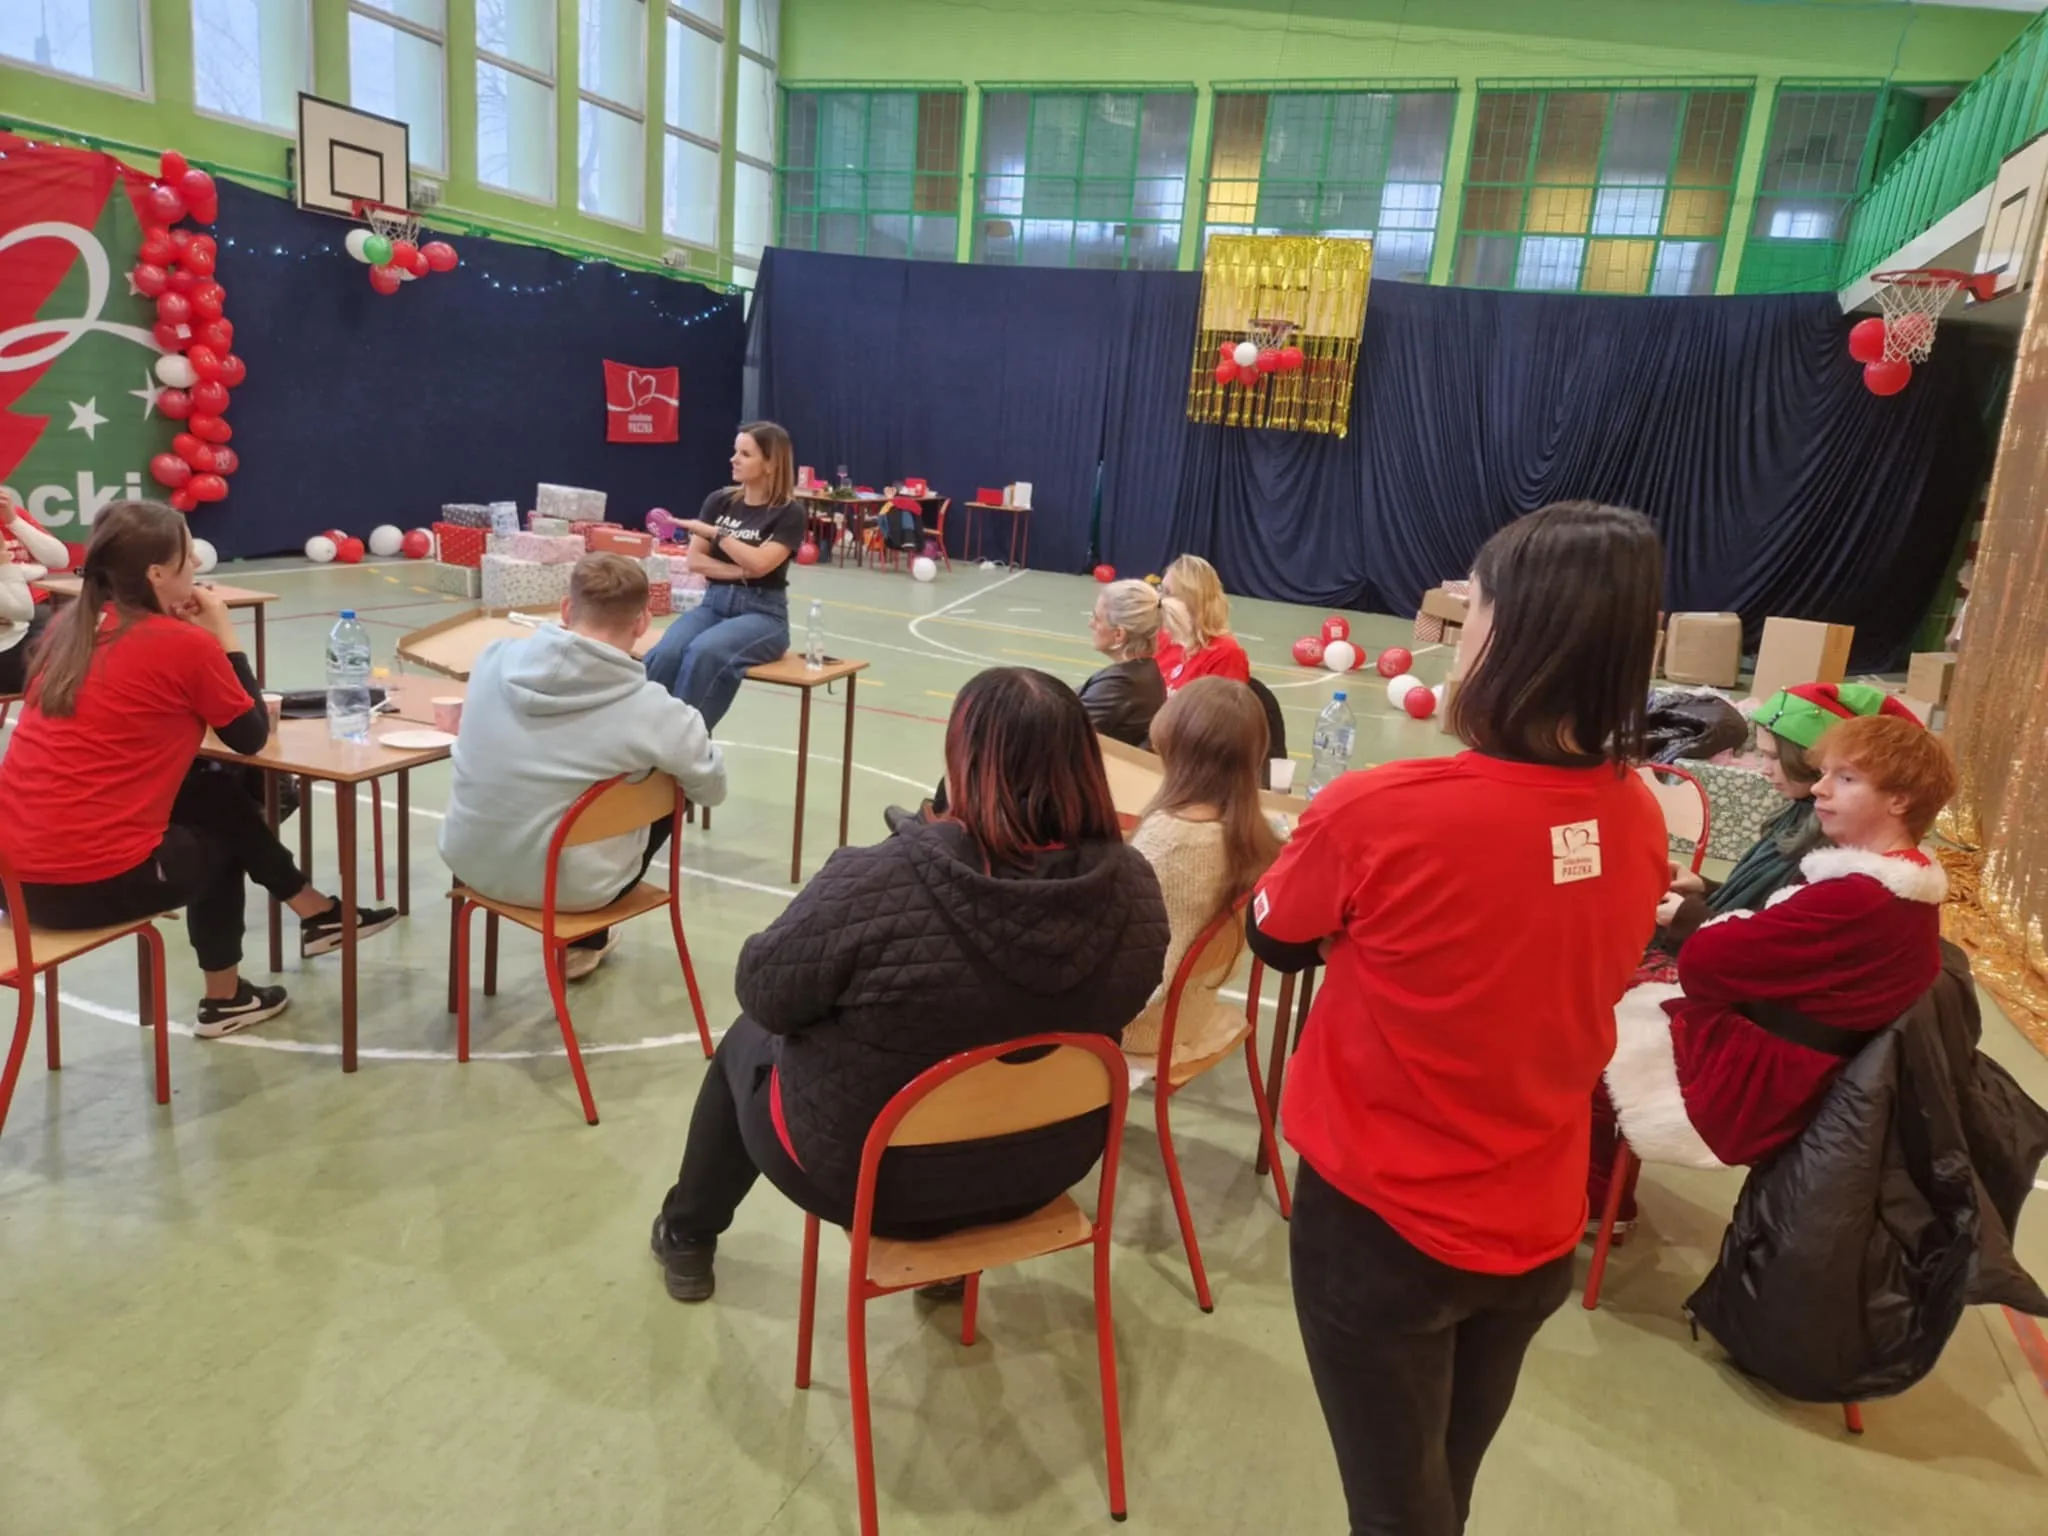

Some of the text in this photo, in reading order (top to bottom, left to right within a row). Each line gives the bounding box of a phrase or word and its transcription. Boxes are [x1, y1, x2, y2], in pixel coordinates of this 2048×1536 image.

[0, 471, 142, 527] cki
[715, 515, 742, 528] I AM
